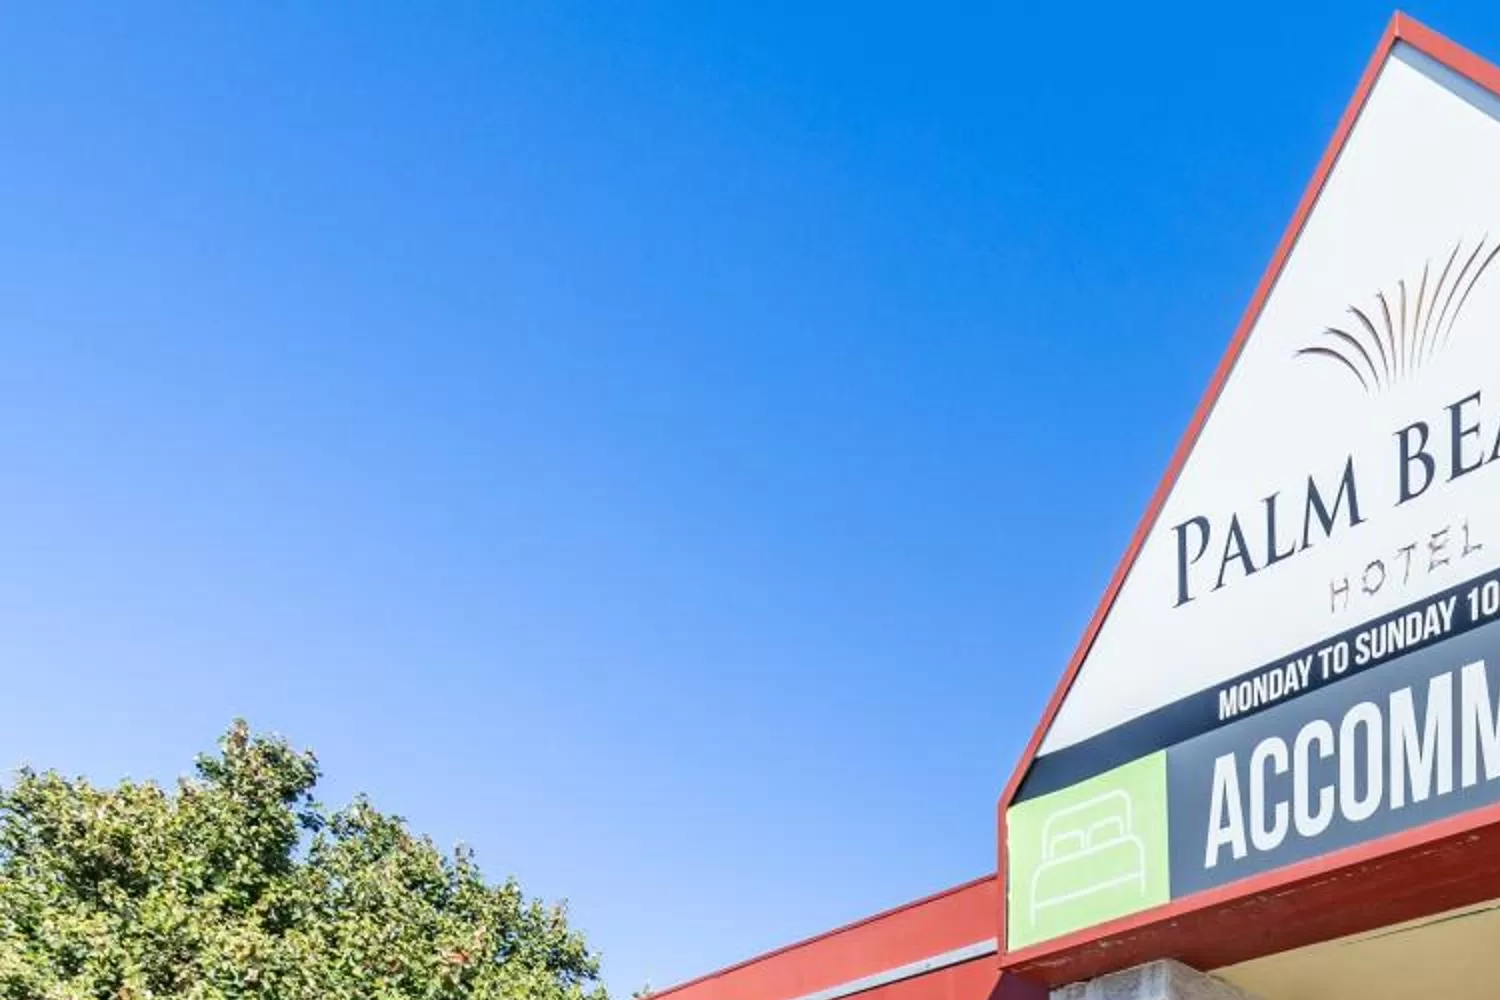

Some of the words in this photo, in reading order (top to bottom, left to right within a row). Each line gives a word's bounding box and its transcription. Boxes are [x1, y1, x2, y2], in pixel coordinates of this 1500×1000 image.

[1171, 453, 1368, 609] PALM
[1329, 518, 1483, 614] HOTEL
[1218, 654, 1313, 721] MONDAY
[1317, 641, 1350, 680] TO
[1355, 596, 1458, 665] SUNDAY
